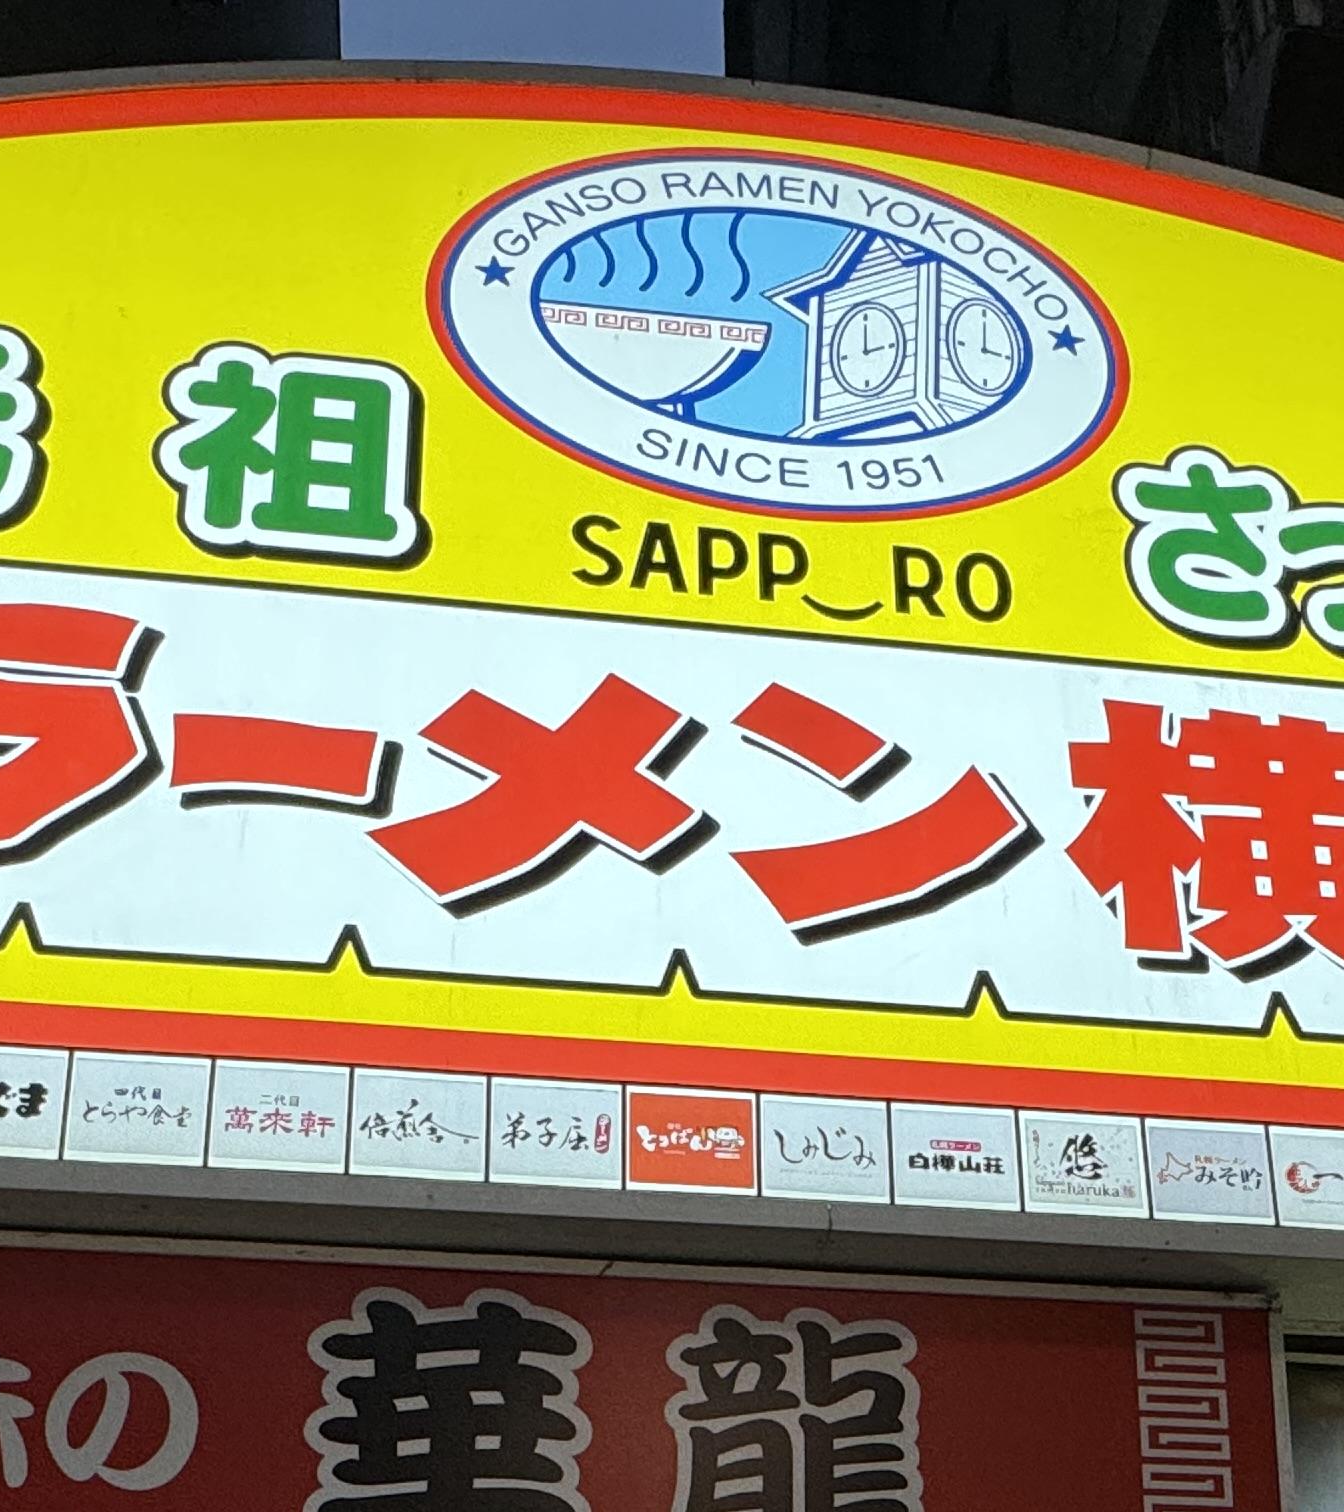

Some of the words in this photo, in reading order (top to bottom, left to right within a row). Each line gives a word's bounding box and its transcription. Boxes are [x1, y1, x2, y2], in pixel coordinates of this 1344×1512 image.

[492, 175, 648, 260] GANSO
[660, 171, 841, 210] RAMEN
[856, 188, 1070, 324] YOKOCHO
[635, 429, 810, 488] SINCE
[837, 454, 947, 491] 1951
[82, 1099, 192, 1129] とらや食堂
[773, 1126, 876, 1170] しみじみ
[908, 1152, 1006, 1175] 白樺山荘
[1059, 1133, 1108, 1180] 悠
